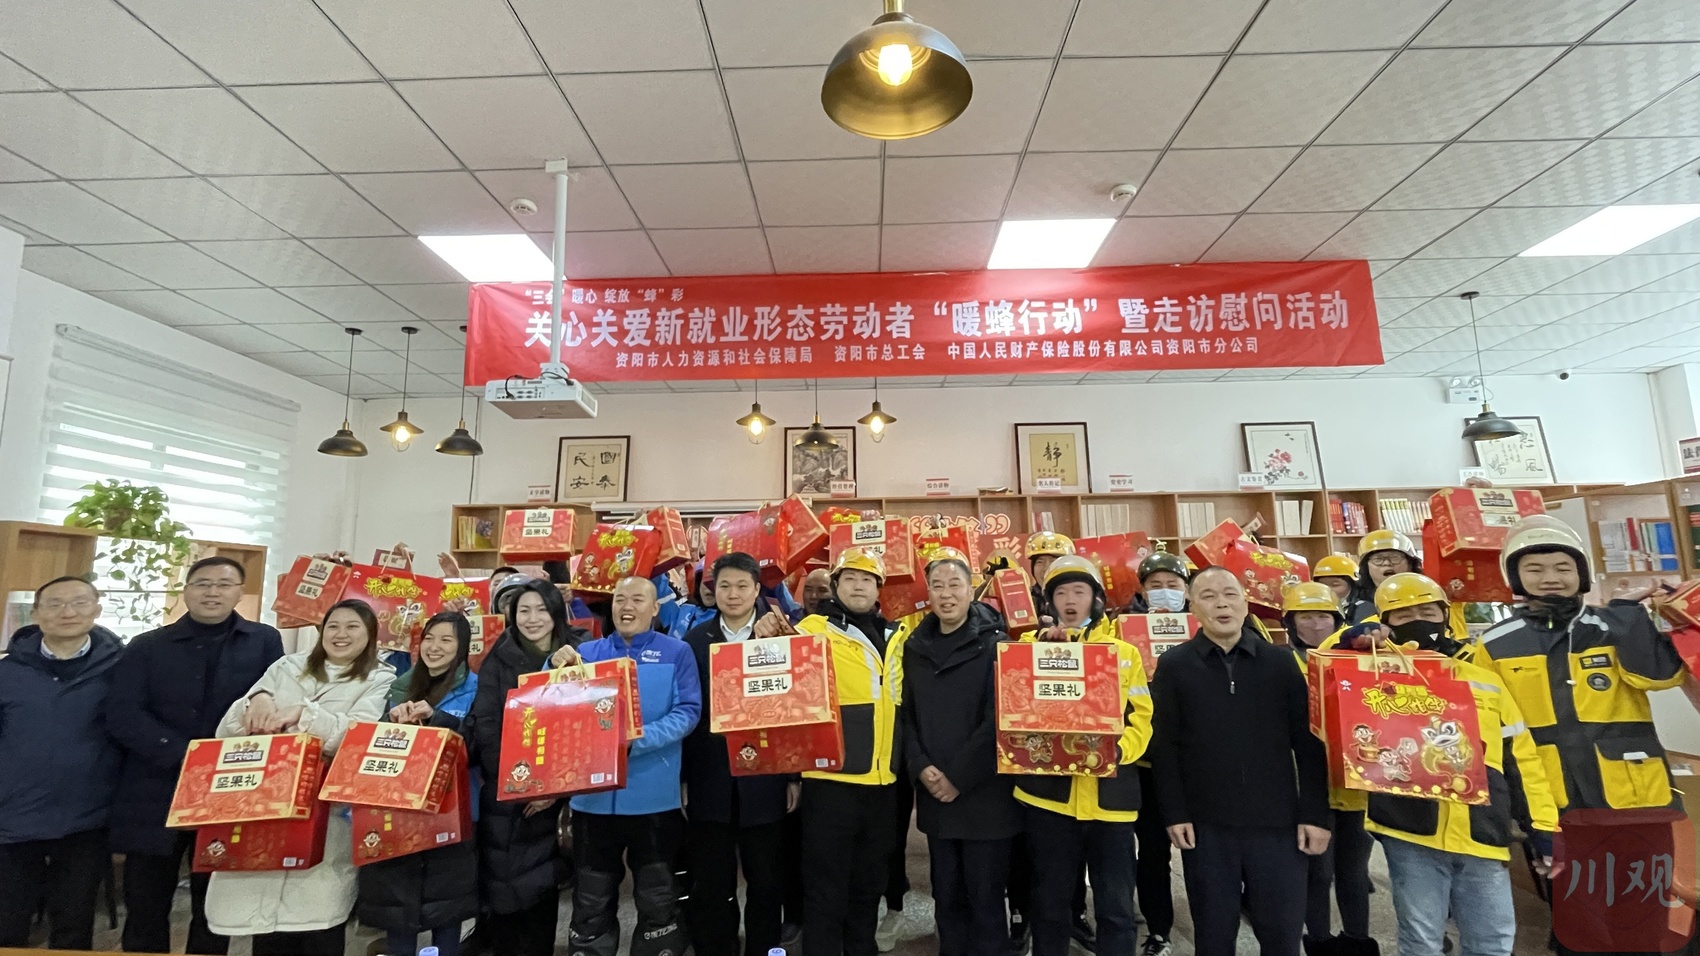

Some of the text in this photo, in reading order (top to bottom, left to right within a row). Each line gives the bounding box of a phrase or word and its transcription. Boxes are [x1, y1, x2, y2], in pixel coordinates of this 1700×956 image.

[616, 336, 1258, 368] 资阳市人力资源和社会保障局 资阳市总工会 中国人民财产保险股份有限公司资阳市分公司
[748, 677, 788, 693] 坚果礼
[1038, 683, 1081, 697] 坚果礼
[363, 759, 399, 773] 坚果礼
[215, 774, 258, 789] 坚果礼
